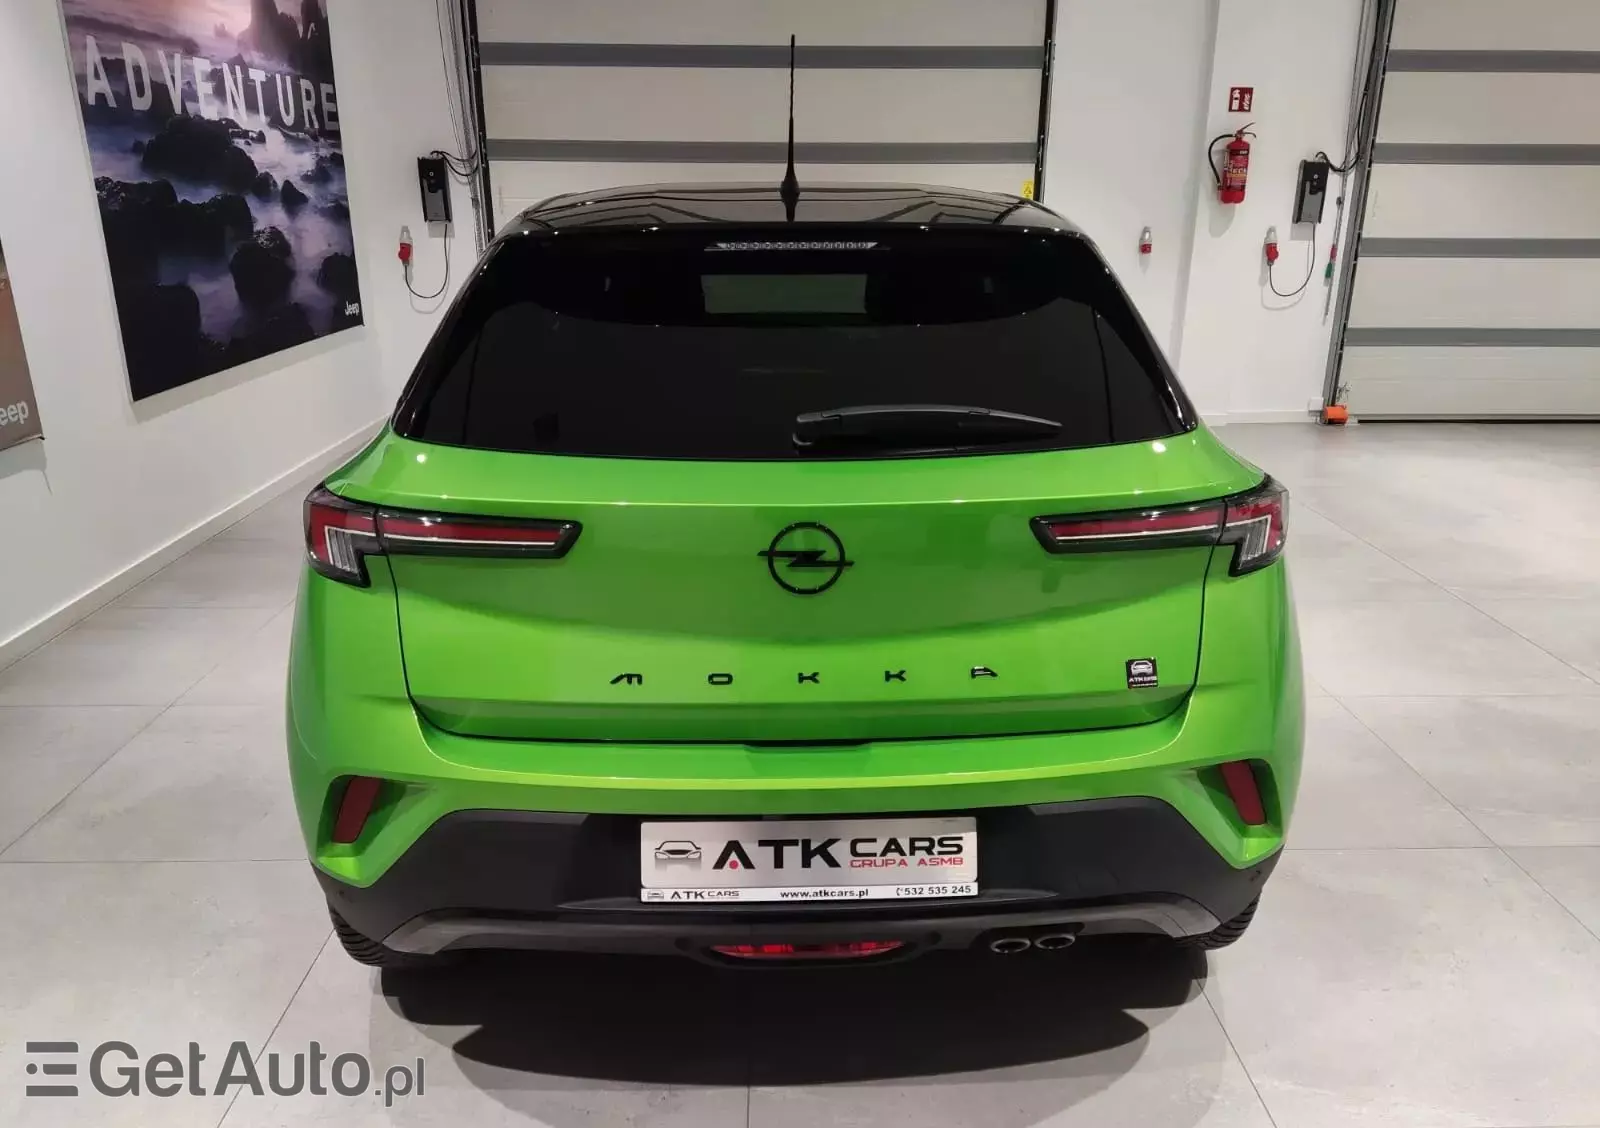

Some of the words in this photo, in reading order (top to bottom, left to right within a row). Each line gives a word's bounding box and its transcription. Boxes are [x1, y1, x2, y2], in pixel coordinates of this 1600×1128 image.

[85, 34, 339, 131] ADVENTURE
[344, 301, 360, 316] Jeep
[609, 665, 998, 686] MOKKA
[712, 838, 842, 869] ATK
[850, 836, 964, 857] CARS
[850, 858, 908, 868] GRUPA
[917, 856, 964, 867] ASMB
[670, 890, 706, 900] ATK
[707, 890, 740, 898] CARS
[780, 889, 869, 900] www.atkcars.pl
[905, 885, 925, 896] 532
[928, 885, 948, 895] 535
[952, 884, 971, 895] 245
